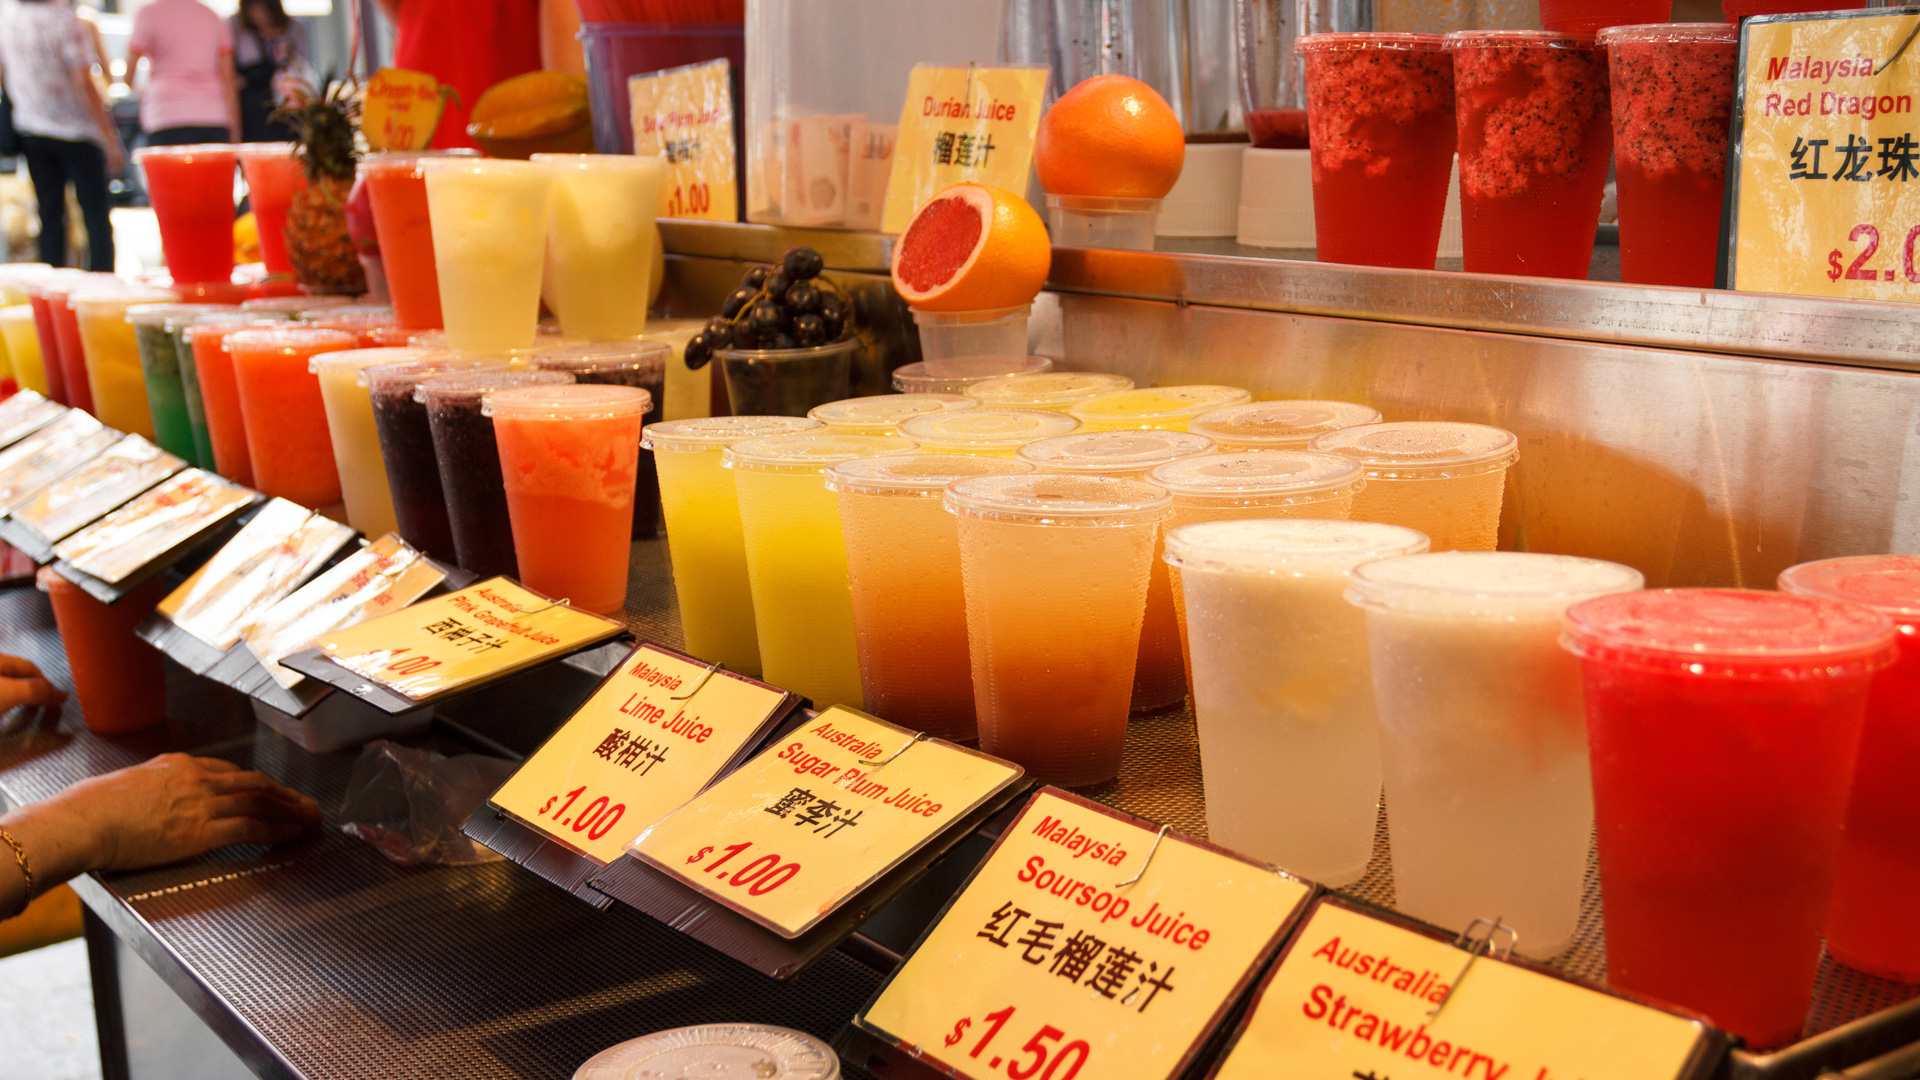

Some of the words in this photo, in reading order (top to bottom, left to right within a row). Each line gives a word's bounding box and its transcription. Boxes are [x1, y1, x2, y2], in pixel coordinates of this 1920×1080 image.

[1767, 54, 1873, 84] Malaysia
[923, 96, 970, 118] Durian
[975, 99, 1016, 121] Juice
[1765, 93, 1811, 117] Red
[1820, 92, 1911, 120] Dragon
[933, 131, 995, 168] 榴莲汁
[668, 183, 710, 217] $1.00
[447, 595, 480, 613] Pink
[473, 609, 534, 635] Grapefruit
[524, 630, 560, 646] Juice
[473, 588, 524, 614] Australia
[421, 617, 510, 654] 西柚子汁
[628, 661, 682, 691] Malaysia
[619, 693, 665, 725] Lime
[662, 710, 713, 743] Juice
[809, 722, 883, 760] Australia
[592, 727, 669, 776] 酸柑汁
[778, 742, 839, 777] Sugar
[835, 767, 889, 800] Plum
[884, 788, 943, 818] Juice
[538, 785, 626, 841] $1.00
[764, 787, 863, 838] 蜜李汁
[1032, 815, 1127, 867] Malaysia
[686, 841, 801, 897] $1.00
[1017, 855, 1130, 923] Soursop
[1130, 903, 1211, 952] Juice
[976, 901, 1174, 1012] 红毛榴莲汁
[1313, 936, 1450, 1003] Australia
[944, 1005, 1090, 1080] $1.50
[1302, 984, 1509, 1080] Strawberry
